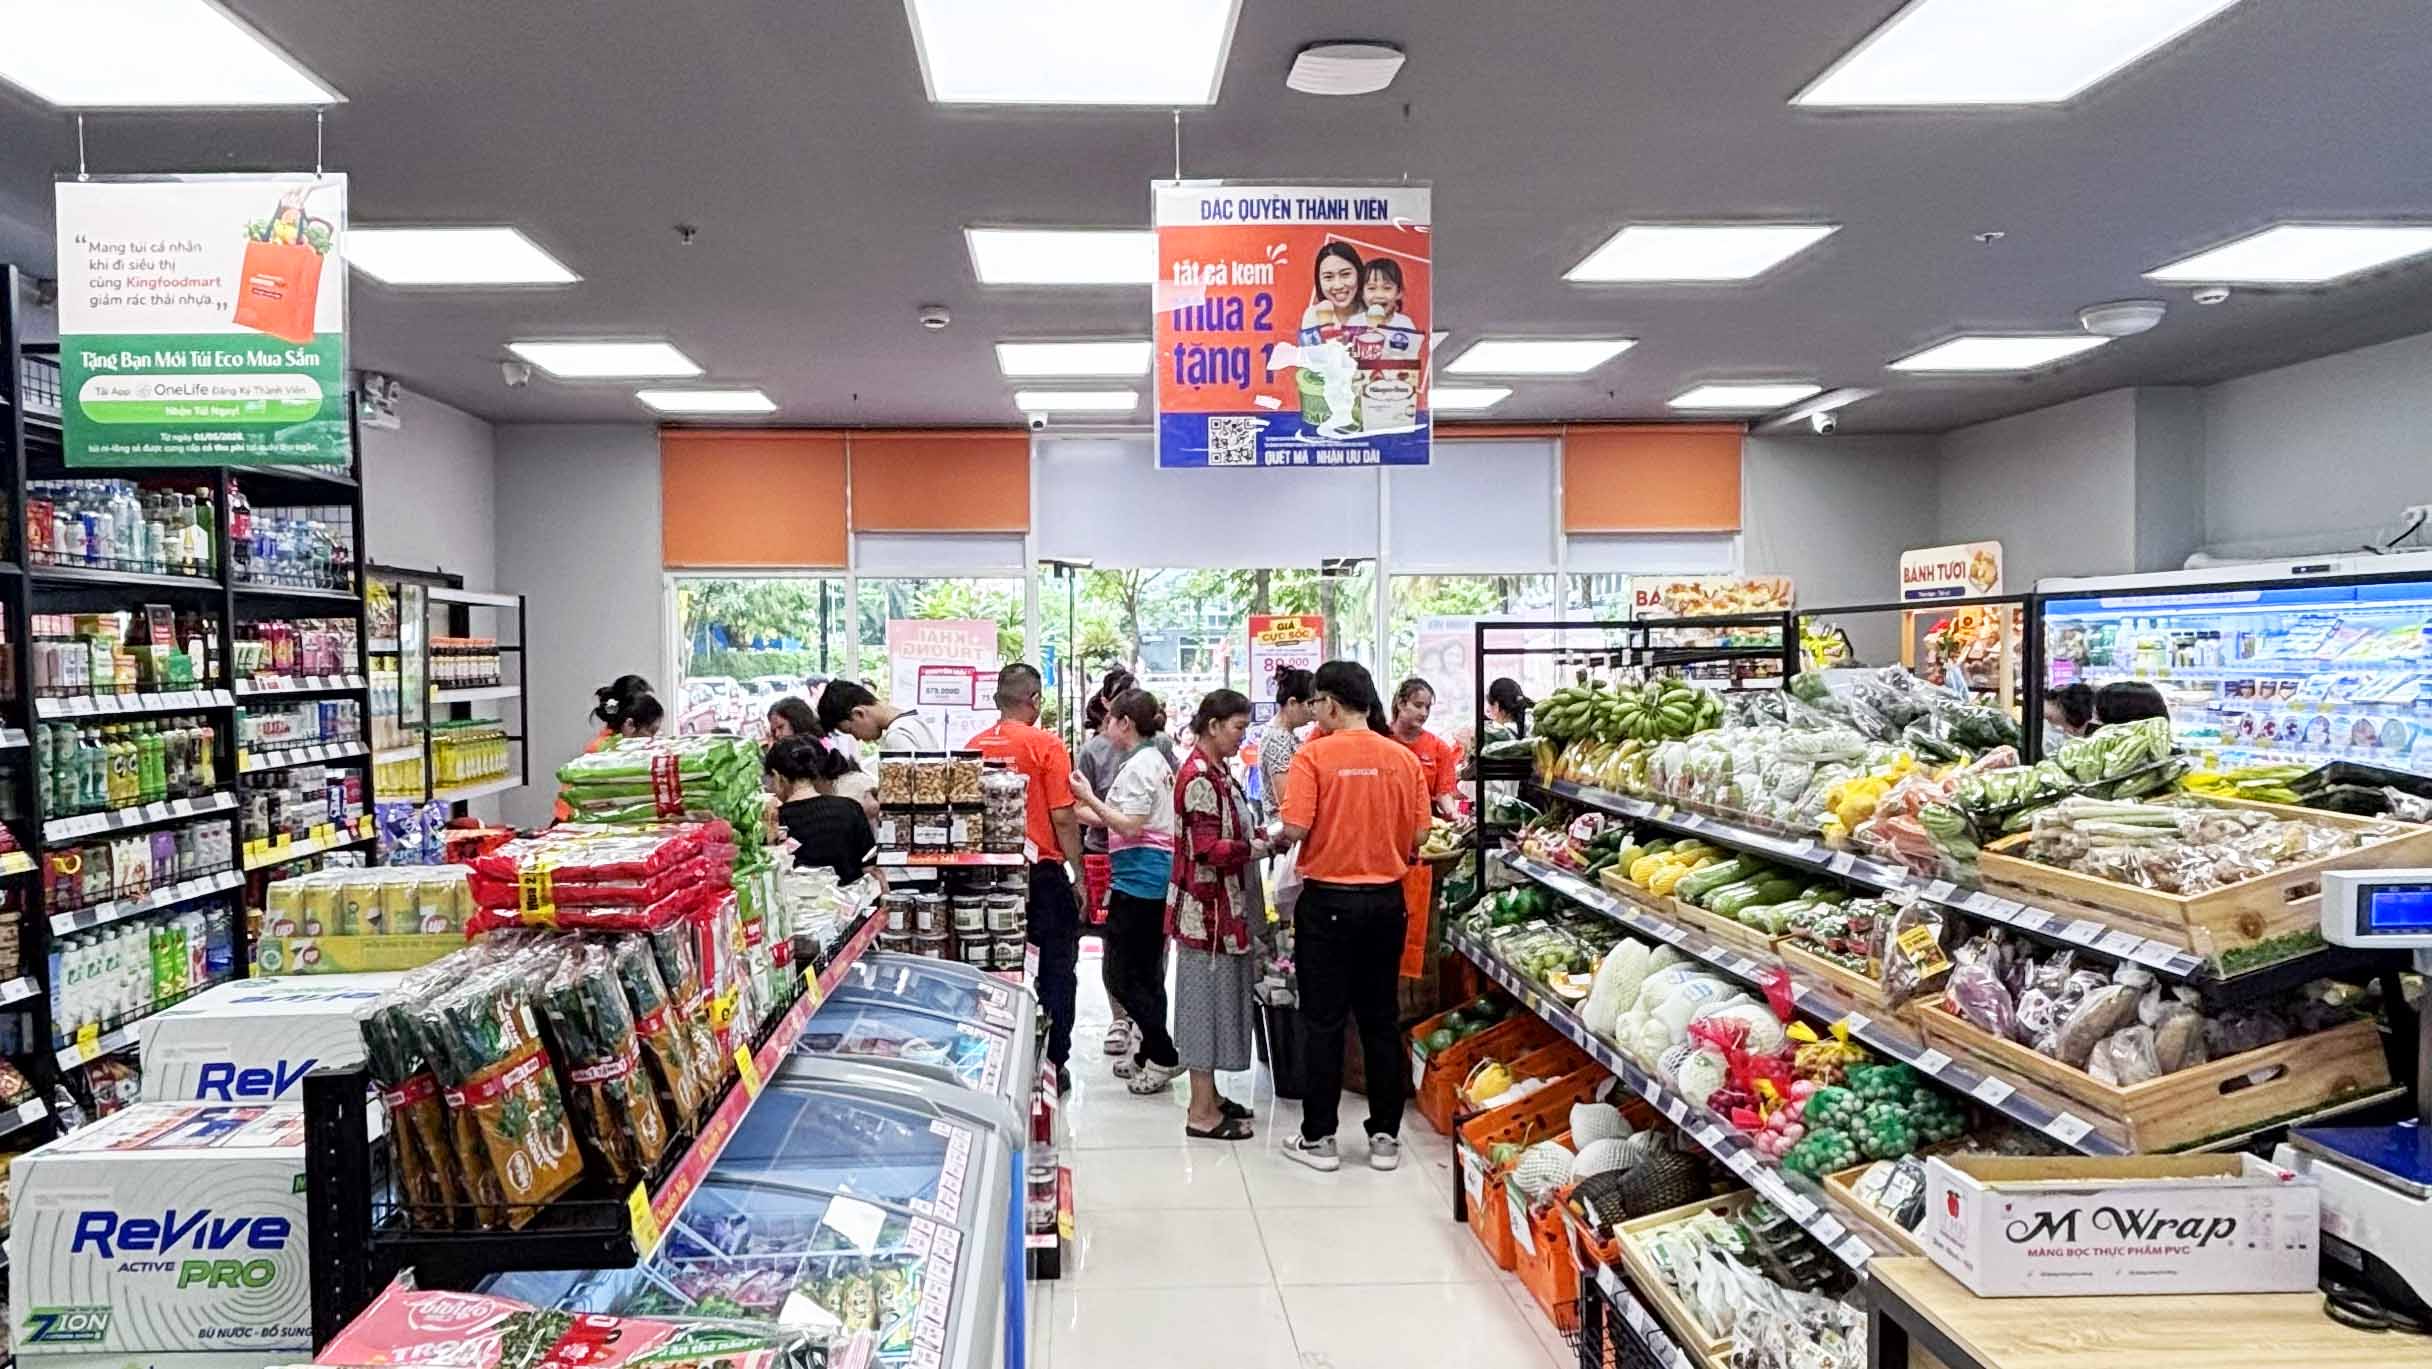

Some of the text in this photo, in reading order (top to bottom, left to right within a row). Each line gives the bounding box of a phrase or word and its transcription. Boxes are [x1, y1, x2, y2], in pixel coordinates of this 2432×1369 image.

[88, 241, 126, 255] Mang
[89, 258, 108, 271] khi
[112, 258, 124, 271] đi
[159, 258, 176, 272] thị
[1232, 261, 1274, 285] kem
[127, 276, 221, 290] Kingfoodmart
[126, 294, 146, 305] rác
[1173, 292, 1273, 331] mua 2
[80, 350, 118, 372] Tặng
[120, 350, 151, 371] Bạn
[190, 350, 212, 368] Túi
[214, 350, 243, 368] Eco
[246, 350, 282, 368] Mua
[285, 346, 320, 368] Sắm
[1174, 342, 1250, 391] tặng
[153, 383, 209, 397] OneLife
[1276, 620, 1295, 631] GIÁ
[71, 1209, 291, 1258] ReVive
[2006, 1206, 2237, 1247] M Wrap
[2066, 1247, 2090, 1259] BỌC
[2164, 1245, 2191, 1256] PVC
[118, 1261, 176, 1273] ACTIVE
[177, 1259, 276, 1289] PRO
